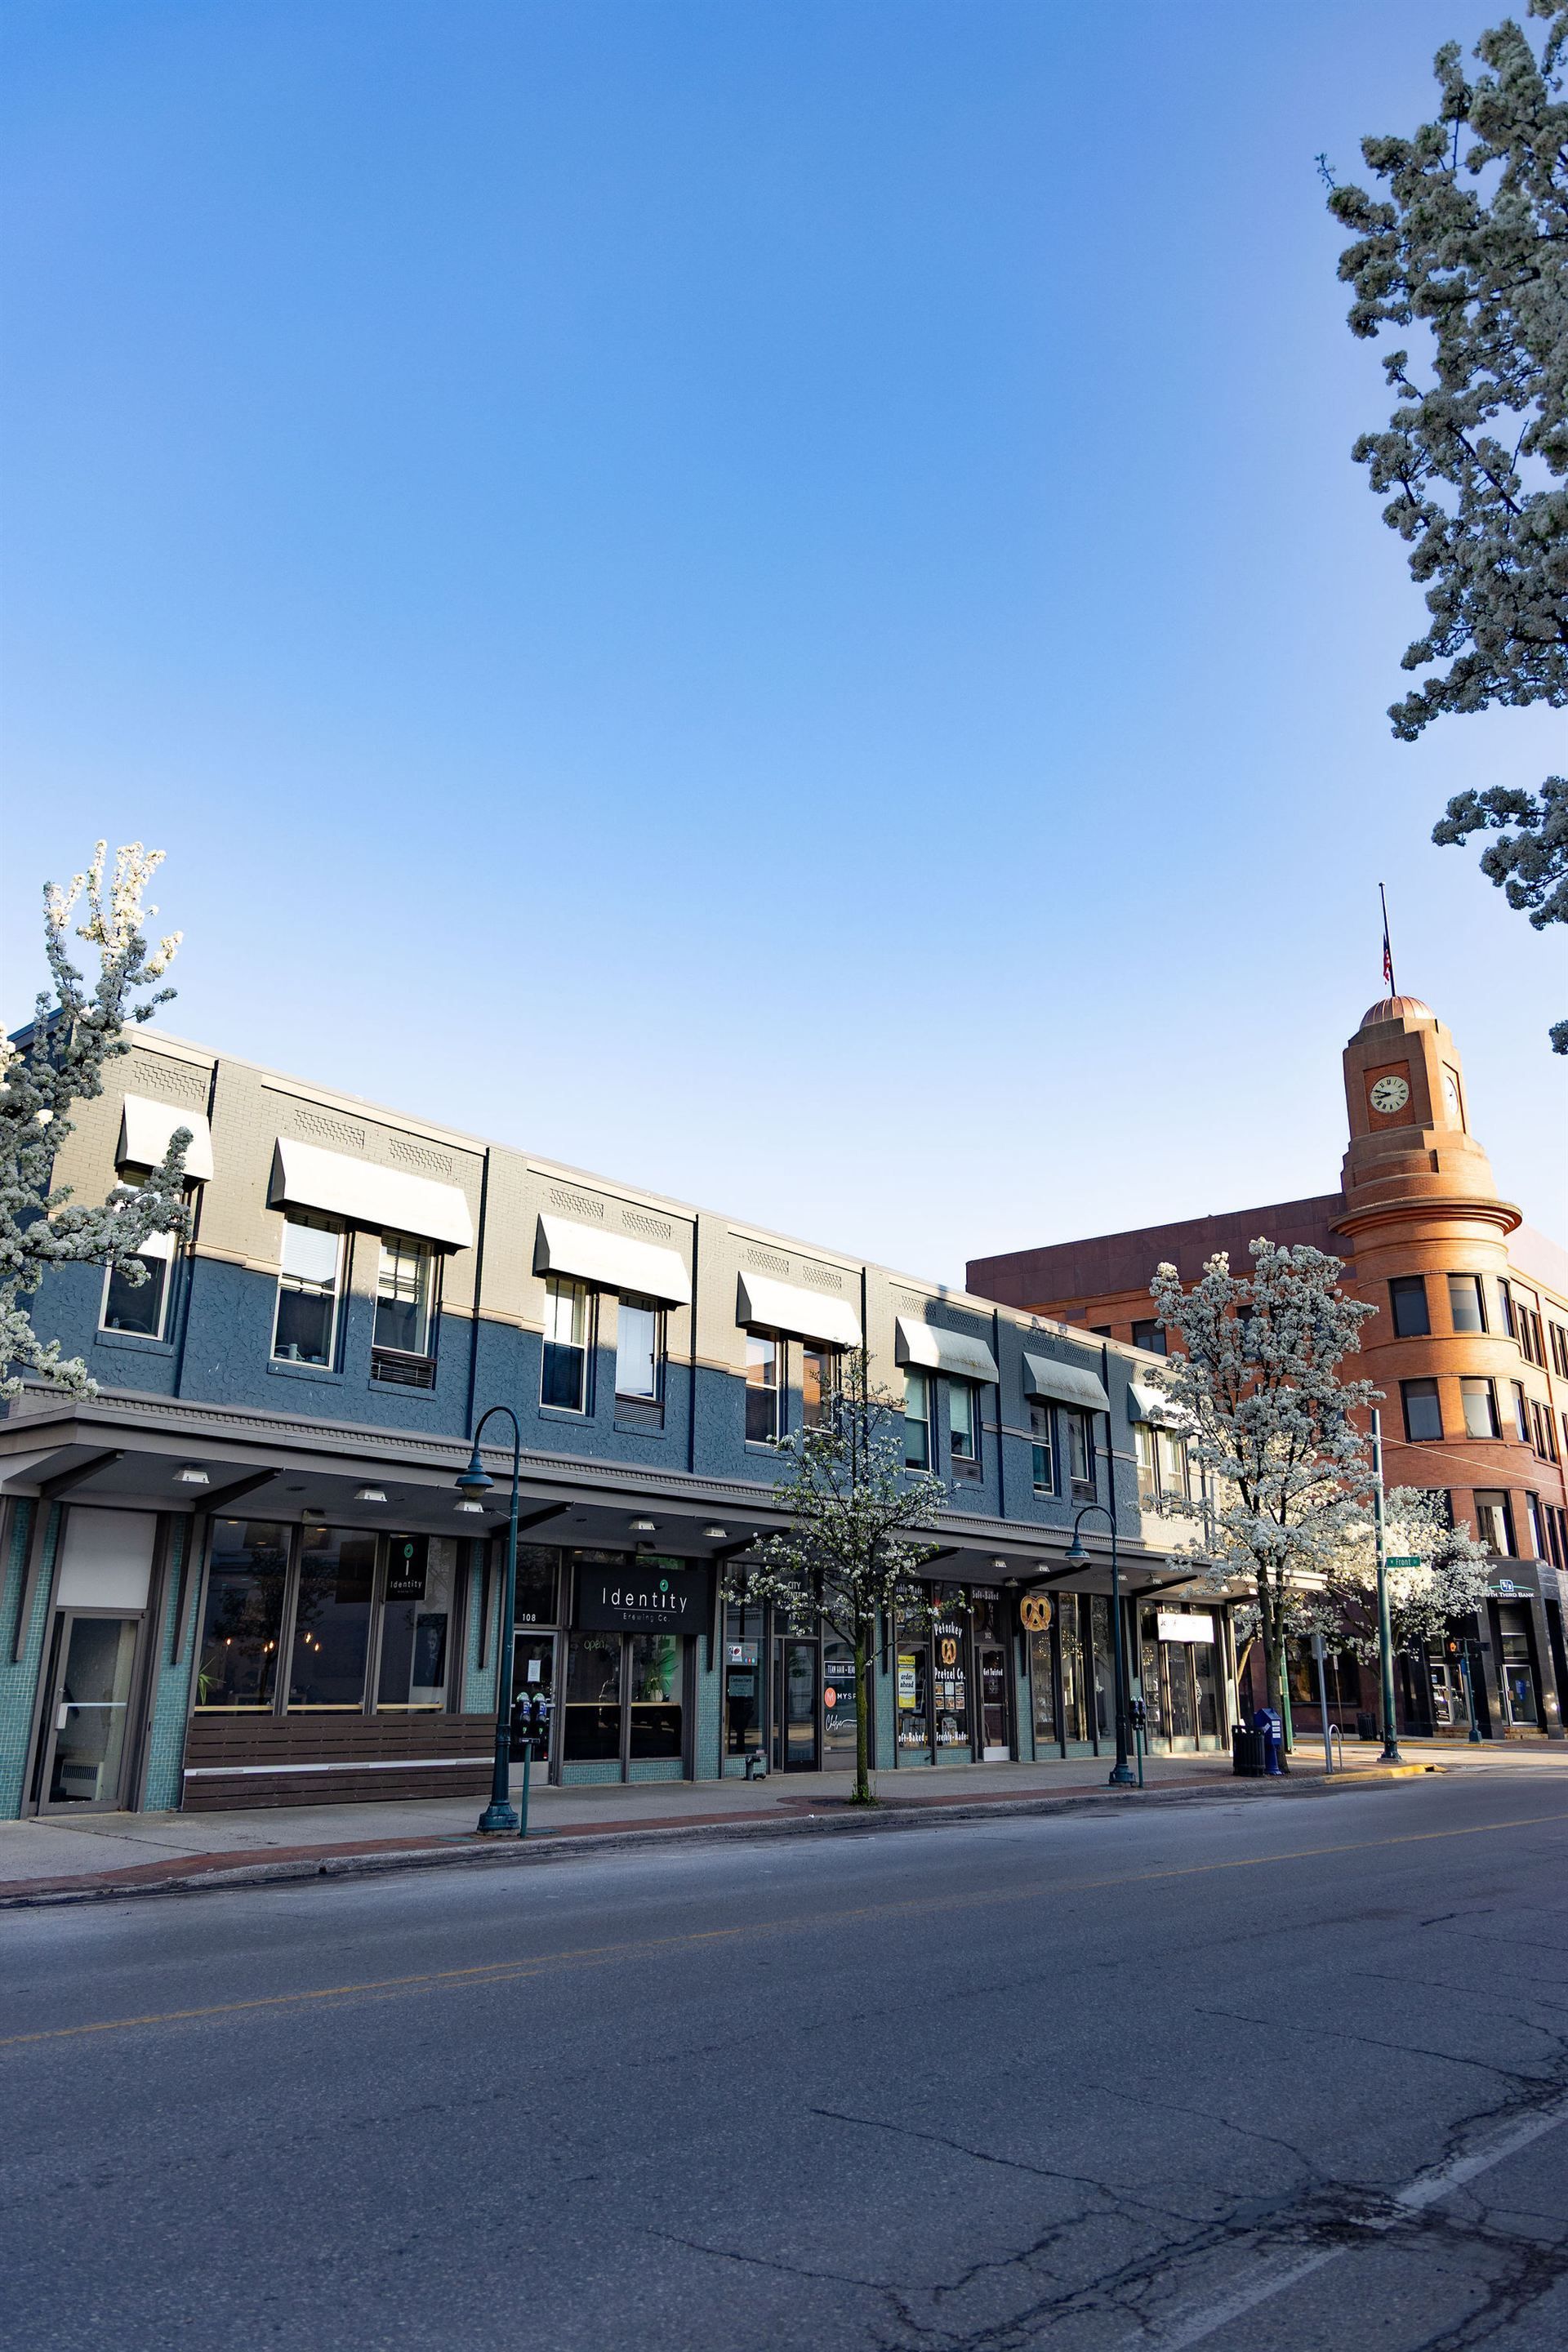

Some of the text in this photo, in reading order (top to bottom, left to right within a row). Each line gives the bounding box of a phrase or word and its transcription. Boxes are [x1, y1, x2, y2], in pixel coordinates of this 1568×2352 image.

[390, 1579, 422, 1588] Identity
[788, 1581, 801, 1590] CITY
[603, 1581, 688, 1614] Identity
[522, 1613, 537, 1623] 108
[933, 1621, 963, 1638] Petoskey
[934, 1666, 966, 1680] Pretzel Co.
